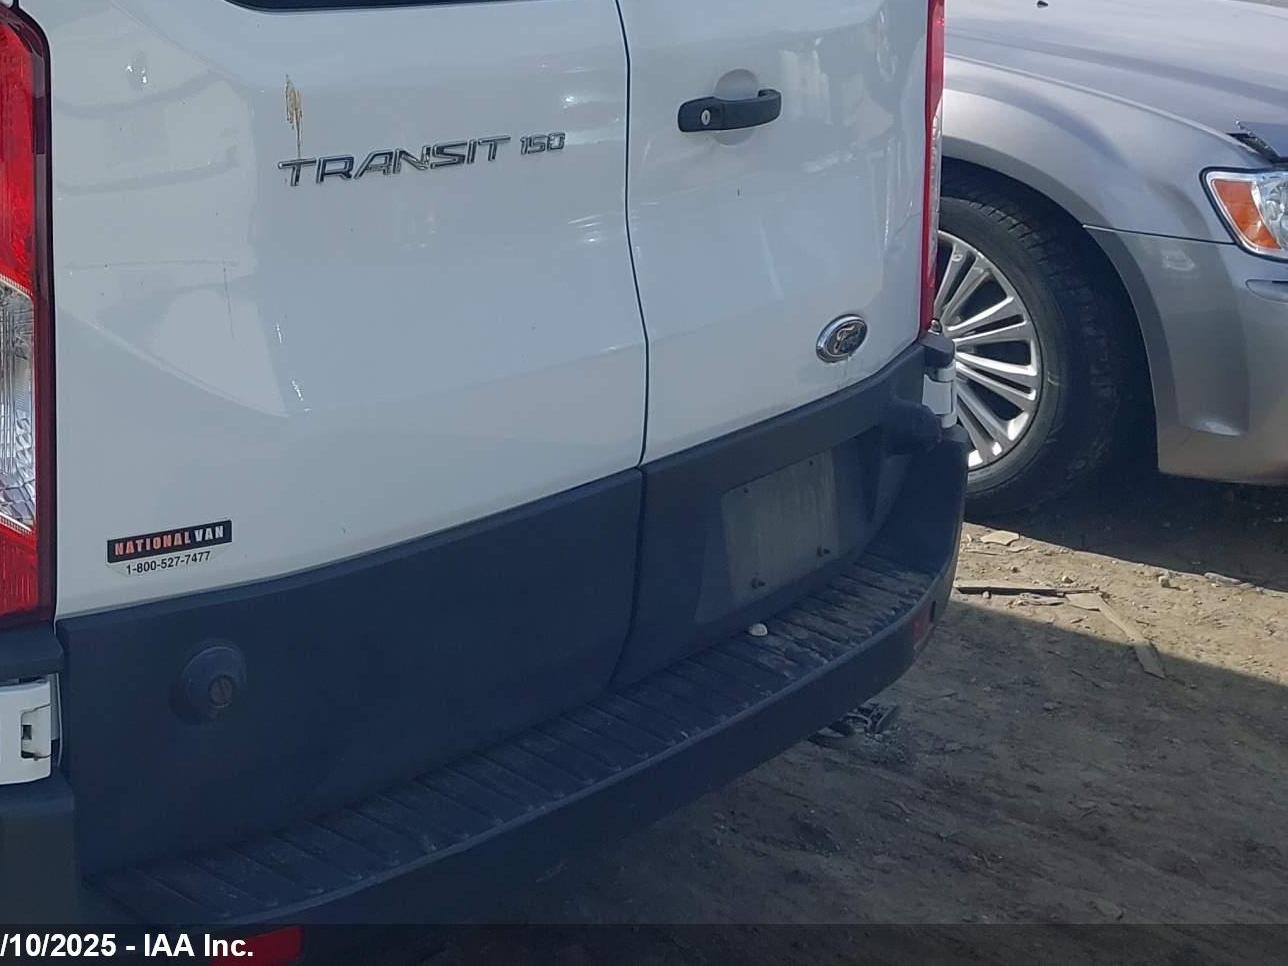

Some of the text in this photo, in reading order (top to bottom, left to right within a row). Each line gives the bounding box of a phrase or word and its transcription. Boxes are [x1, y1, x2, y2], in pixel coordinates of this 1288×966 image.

[277, 132, 566, 187] TRANSIT 150
[115, 526, 224, 555] NATIONAL VAN
[126, 551, 211, 575] 1-800-527-7477
